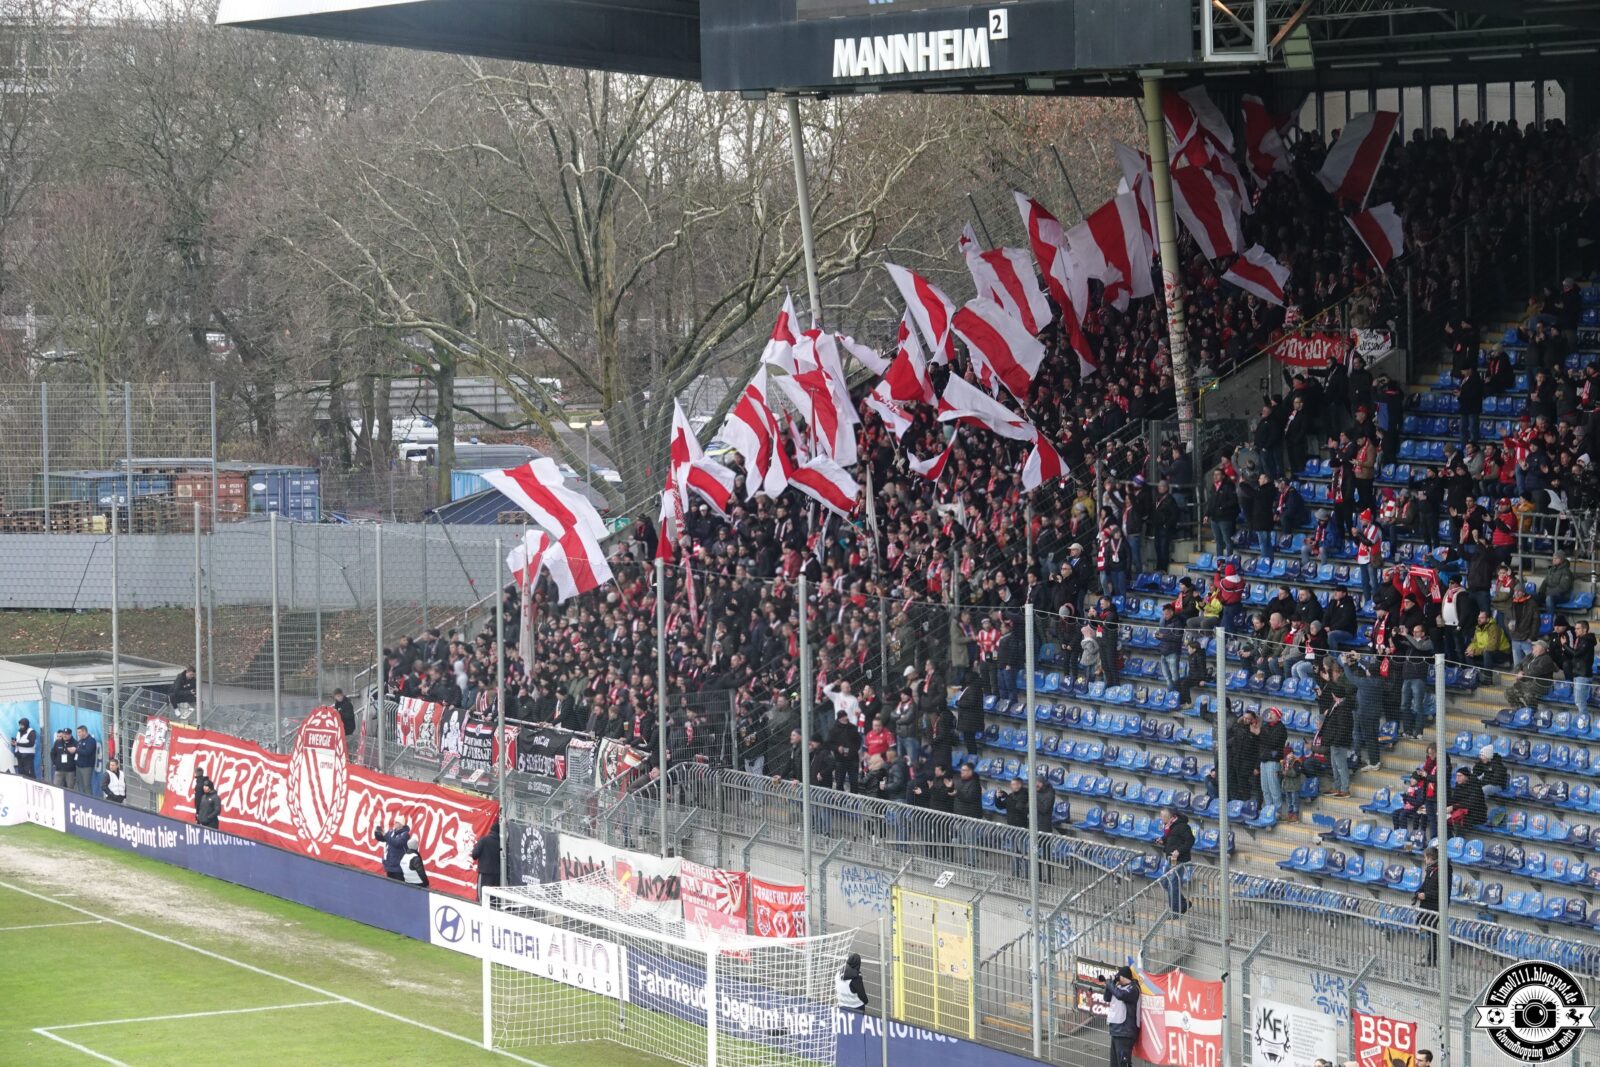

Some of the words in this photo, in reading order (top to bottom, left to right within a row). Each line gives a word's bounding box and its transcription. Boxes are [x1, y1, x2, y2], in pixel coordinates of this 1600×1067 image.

[833, 27, 990, 77] MANNHEIM
[992, 15, 1002, 33] 2
[308, 733, 331, 747] ENERGIE
[69, 803, 118, 838] Fahrfreude
[119, 817, 157, 848] beginnt
[158, 831, 177, 848] hier
[186, 824, 199, 845] Ihr
[471, 919, 540, 960] HUNDAI
[547, 931, 611, 974] AUTO
[547, 963, 612, 992] UNOLD
[637, 965, 710, 1011] Fahrfreud
[720, 988, 781, 1031] beginnt
[783, 1004, 815, 1035] hier
[831, 1006, 855, 1035] Ihr
[1360, 1015, 1411, 1050] BSG
